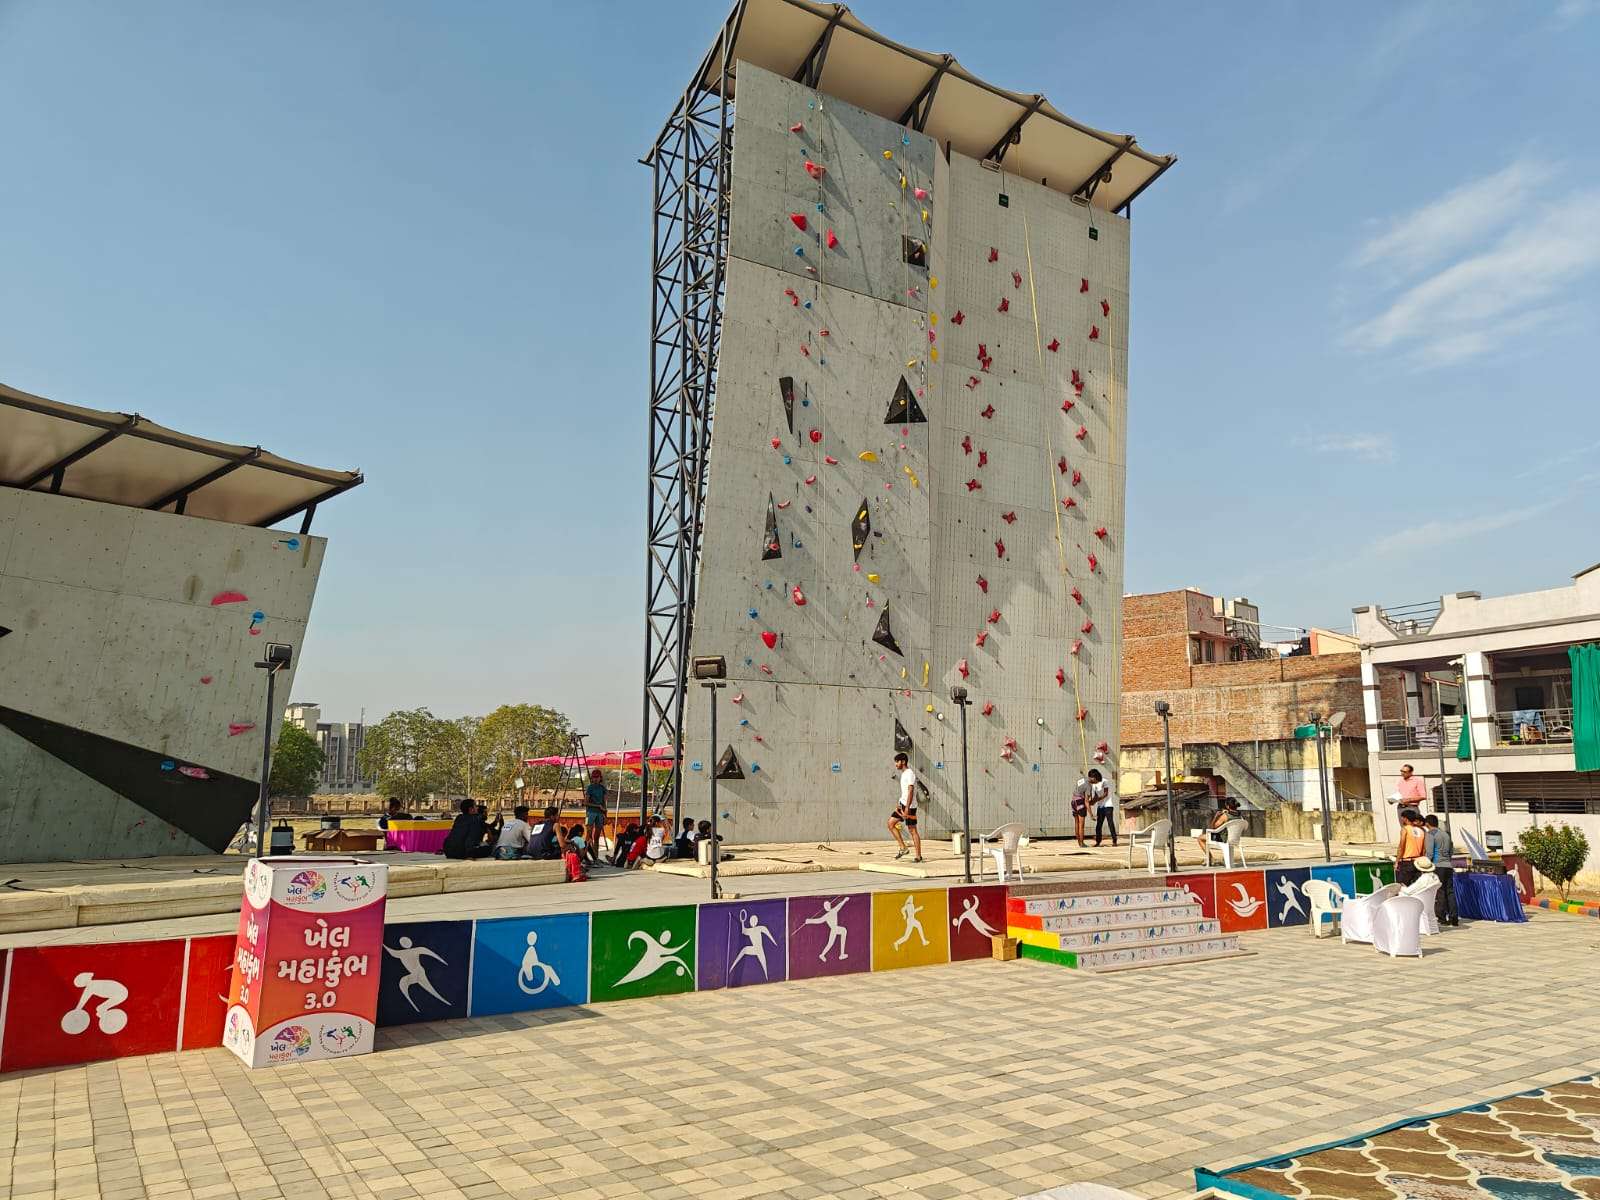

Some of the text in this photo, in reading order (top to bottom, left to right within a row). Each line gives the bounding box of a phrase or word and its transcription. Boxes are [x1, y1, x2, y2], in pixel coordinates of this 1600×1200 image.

[304, 918, 350, 949] ખેલ
[277, 949, 368, 988] મહાકુંભ
[240, 984, 249, 1005] 3.0
[304, 990, 337, 1010] 3.0
[270, 1041, 286, 1052] ખેલ
